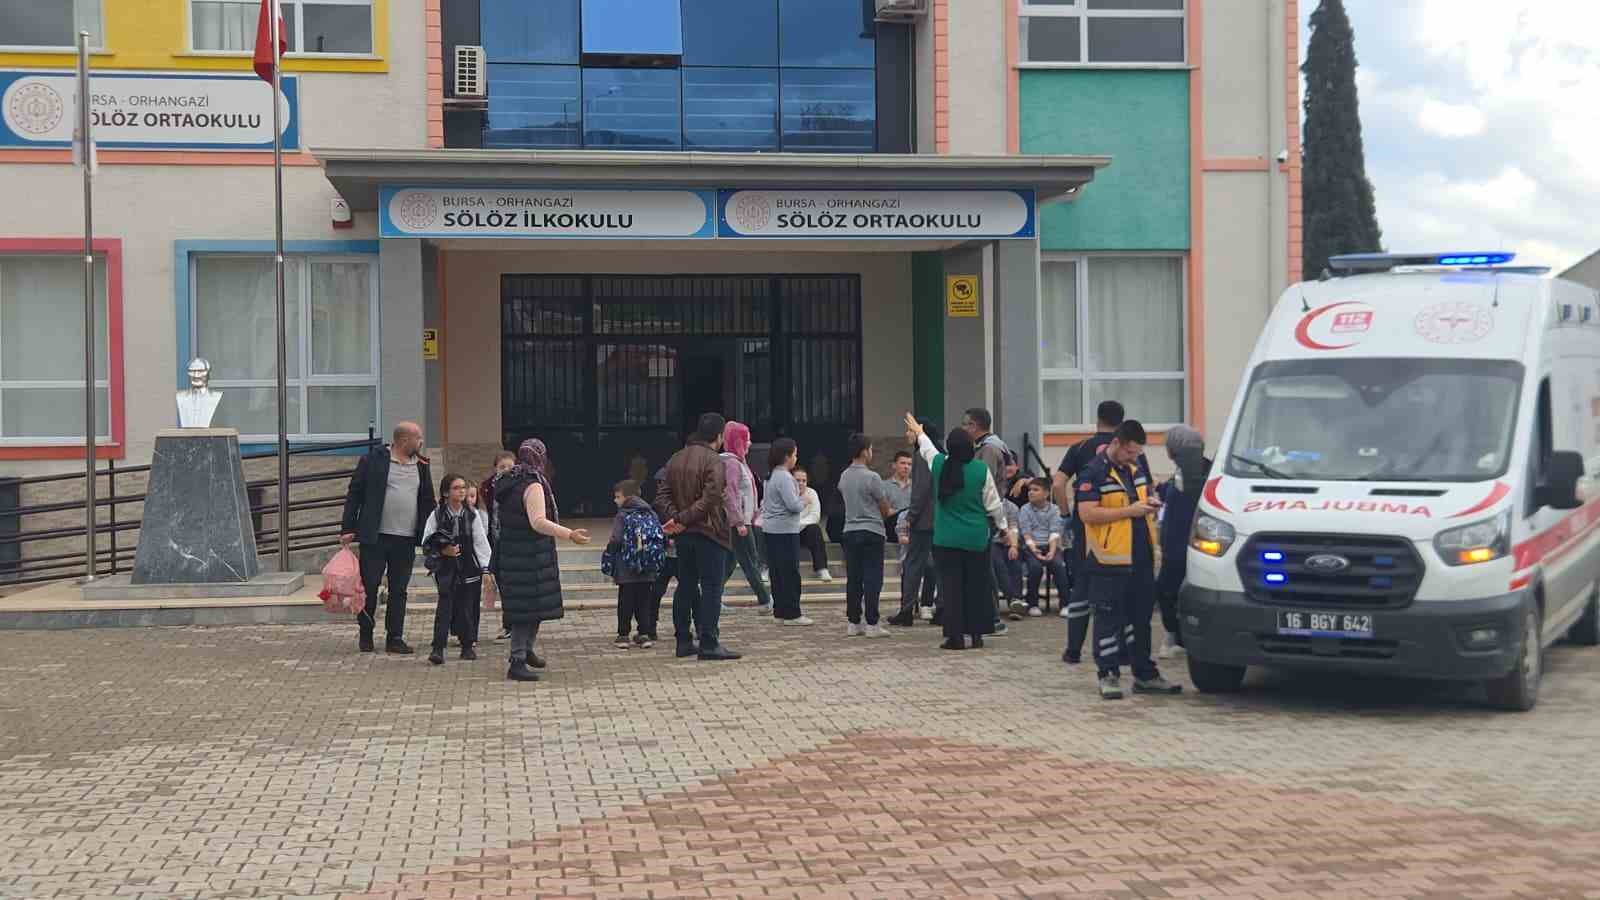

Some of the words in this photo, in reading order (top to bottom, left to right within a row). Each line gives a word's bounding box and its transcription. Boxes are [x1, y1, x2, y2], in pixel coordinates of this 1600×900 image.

[73, 94, 117, 105] RSA
[91, 109, 139, 127] ÖLÖZ
[143, 112, 261, 128] ORTAOKULU
[442, 196, 485, 207] BURSA
[776, 199, 817, 208] BURSA
[443, 209, 518, 227] SÖLÖZ
[523, 210, 633, 228] İLKOKULU
[777, 211, 847, 228] SÖLÖZ
[853, 214, 981, 228] ORTAOKULU
[1286, 612, 1302, 628] 16
[1311, 613, 1337, 630] BGY
[1343, 614, 1369, 632] 642
